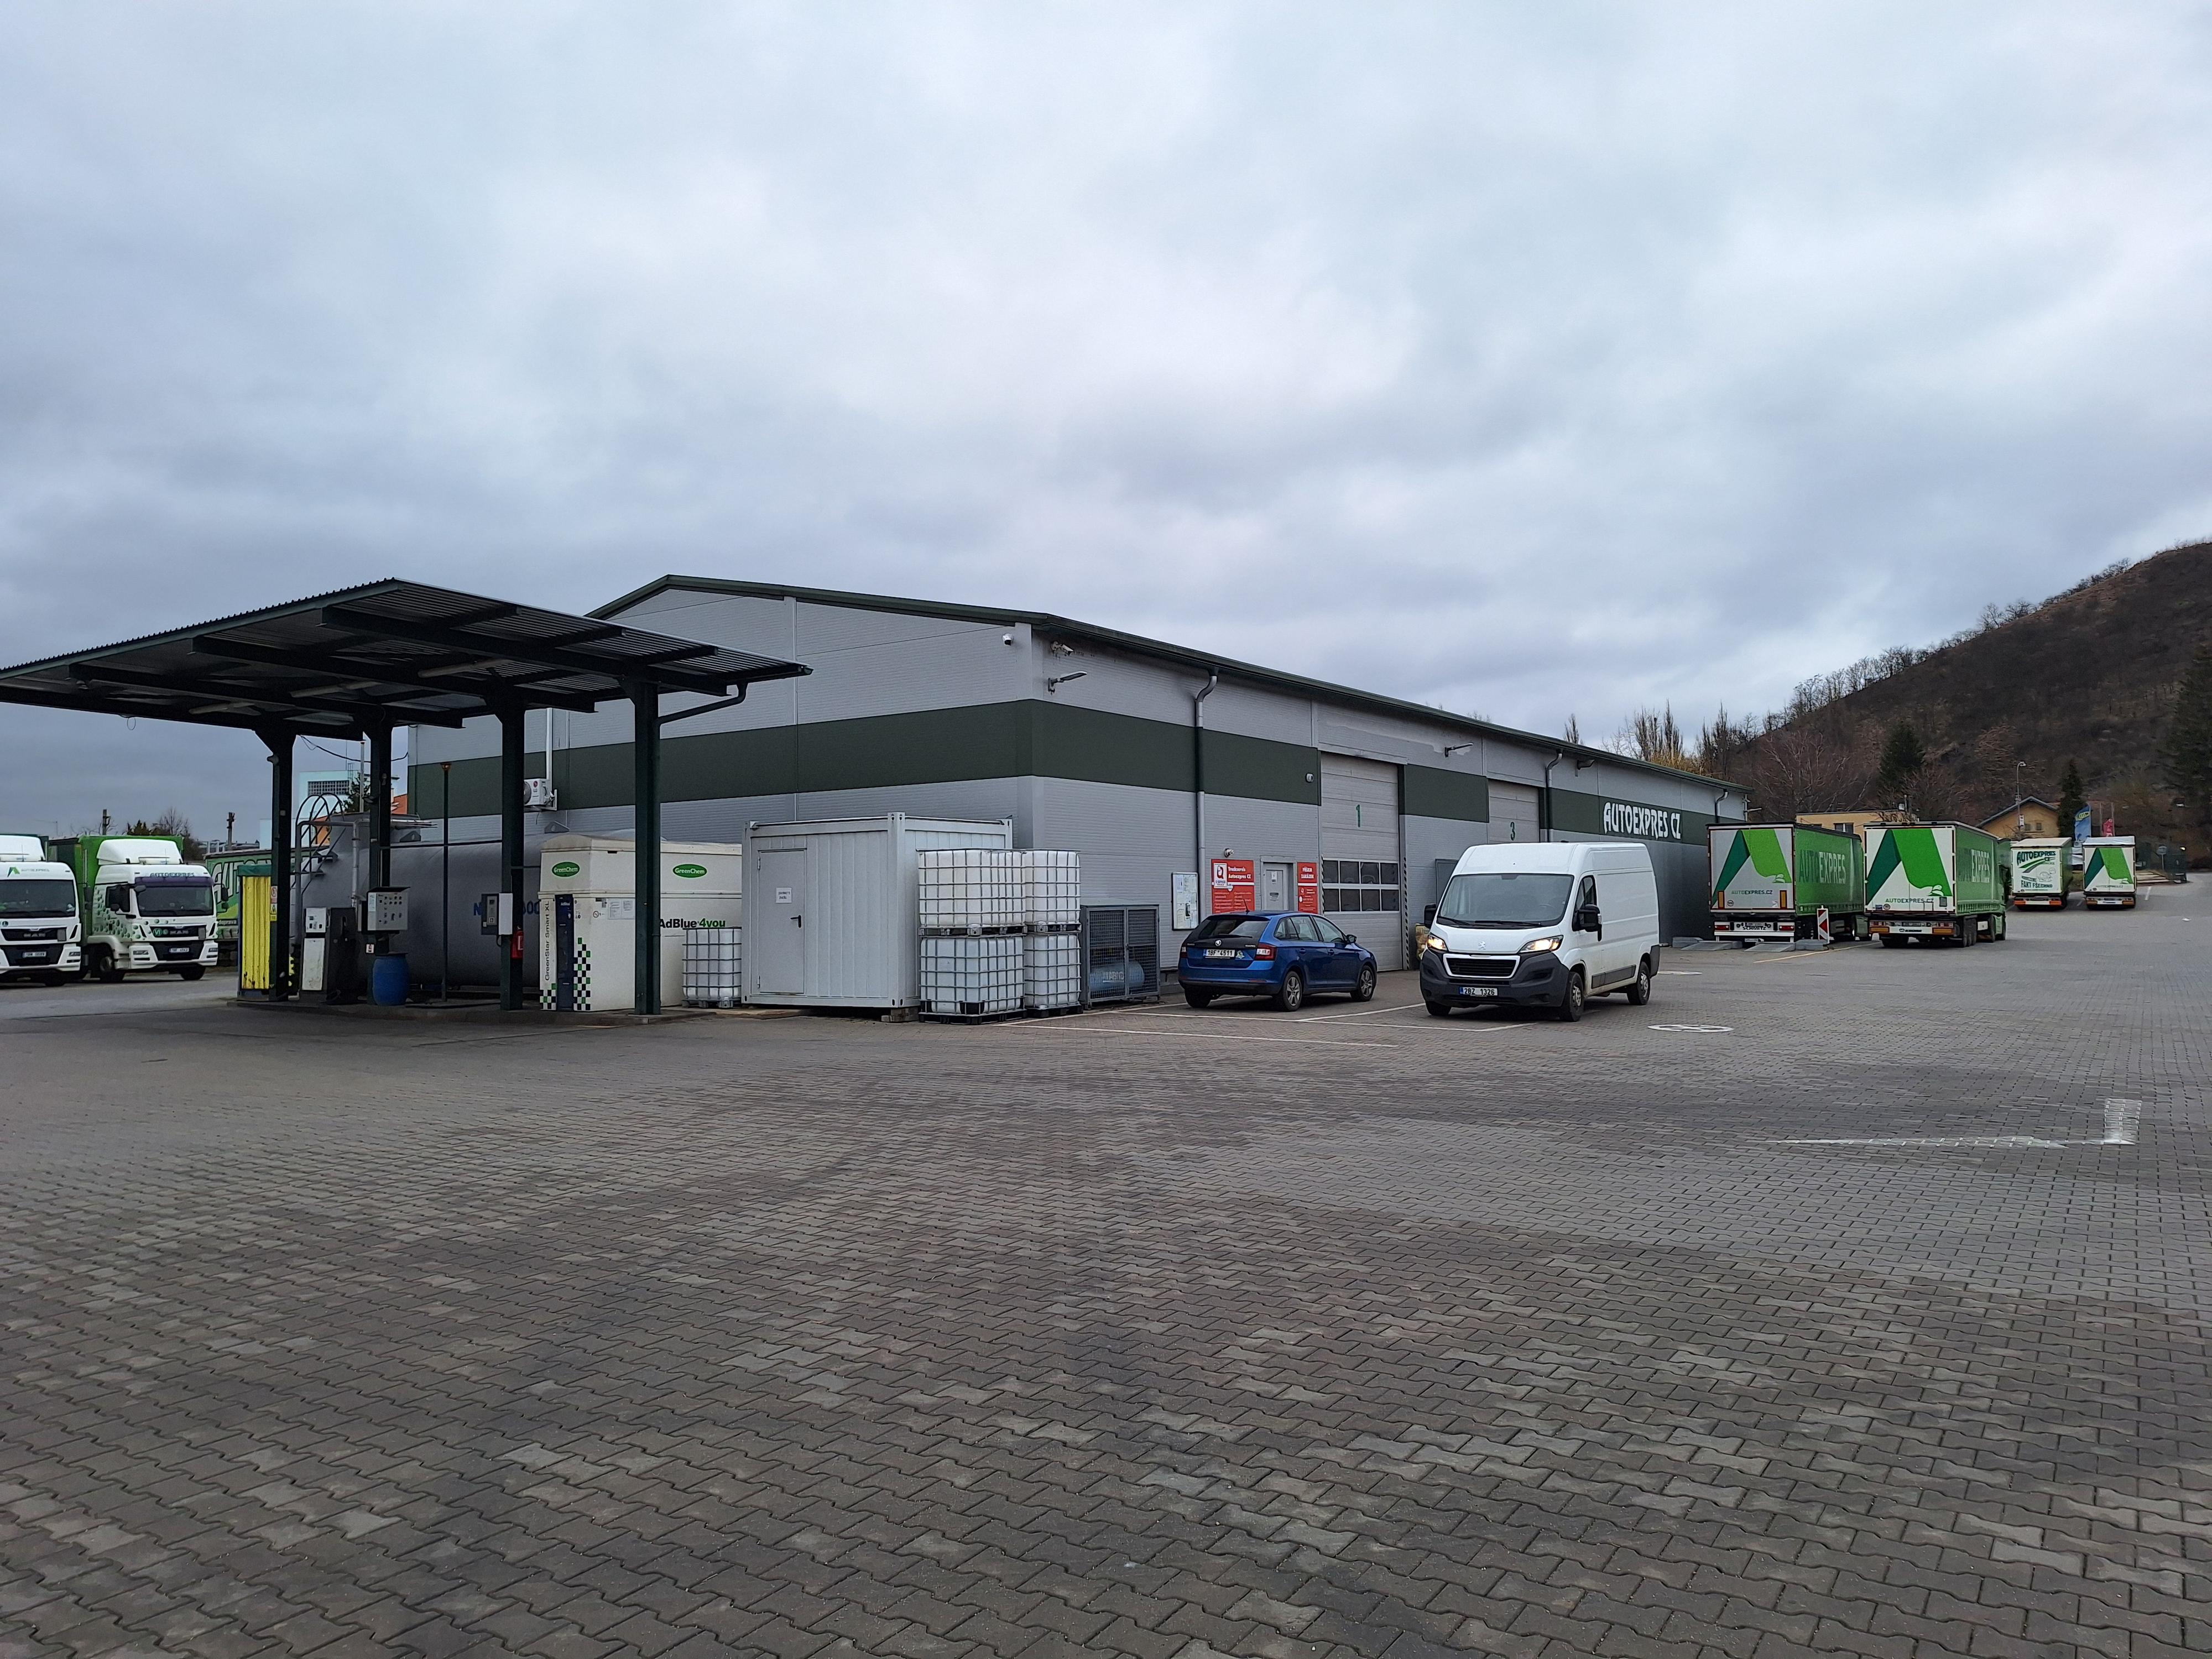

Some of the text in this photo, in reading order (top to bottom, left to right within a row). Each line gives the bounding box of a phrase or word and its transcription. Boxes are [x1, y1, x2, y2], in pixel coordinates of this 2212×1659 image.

[1355, 804, 1360, 828] 1
[1604, 802, 1681, 840] AUTOEXPRES CZ
[1510, 821, 1515, 841] 3
[545, 901, 550, 911] XL
[660, 918, 726, 928] AdBlue 4you
